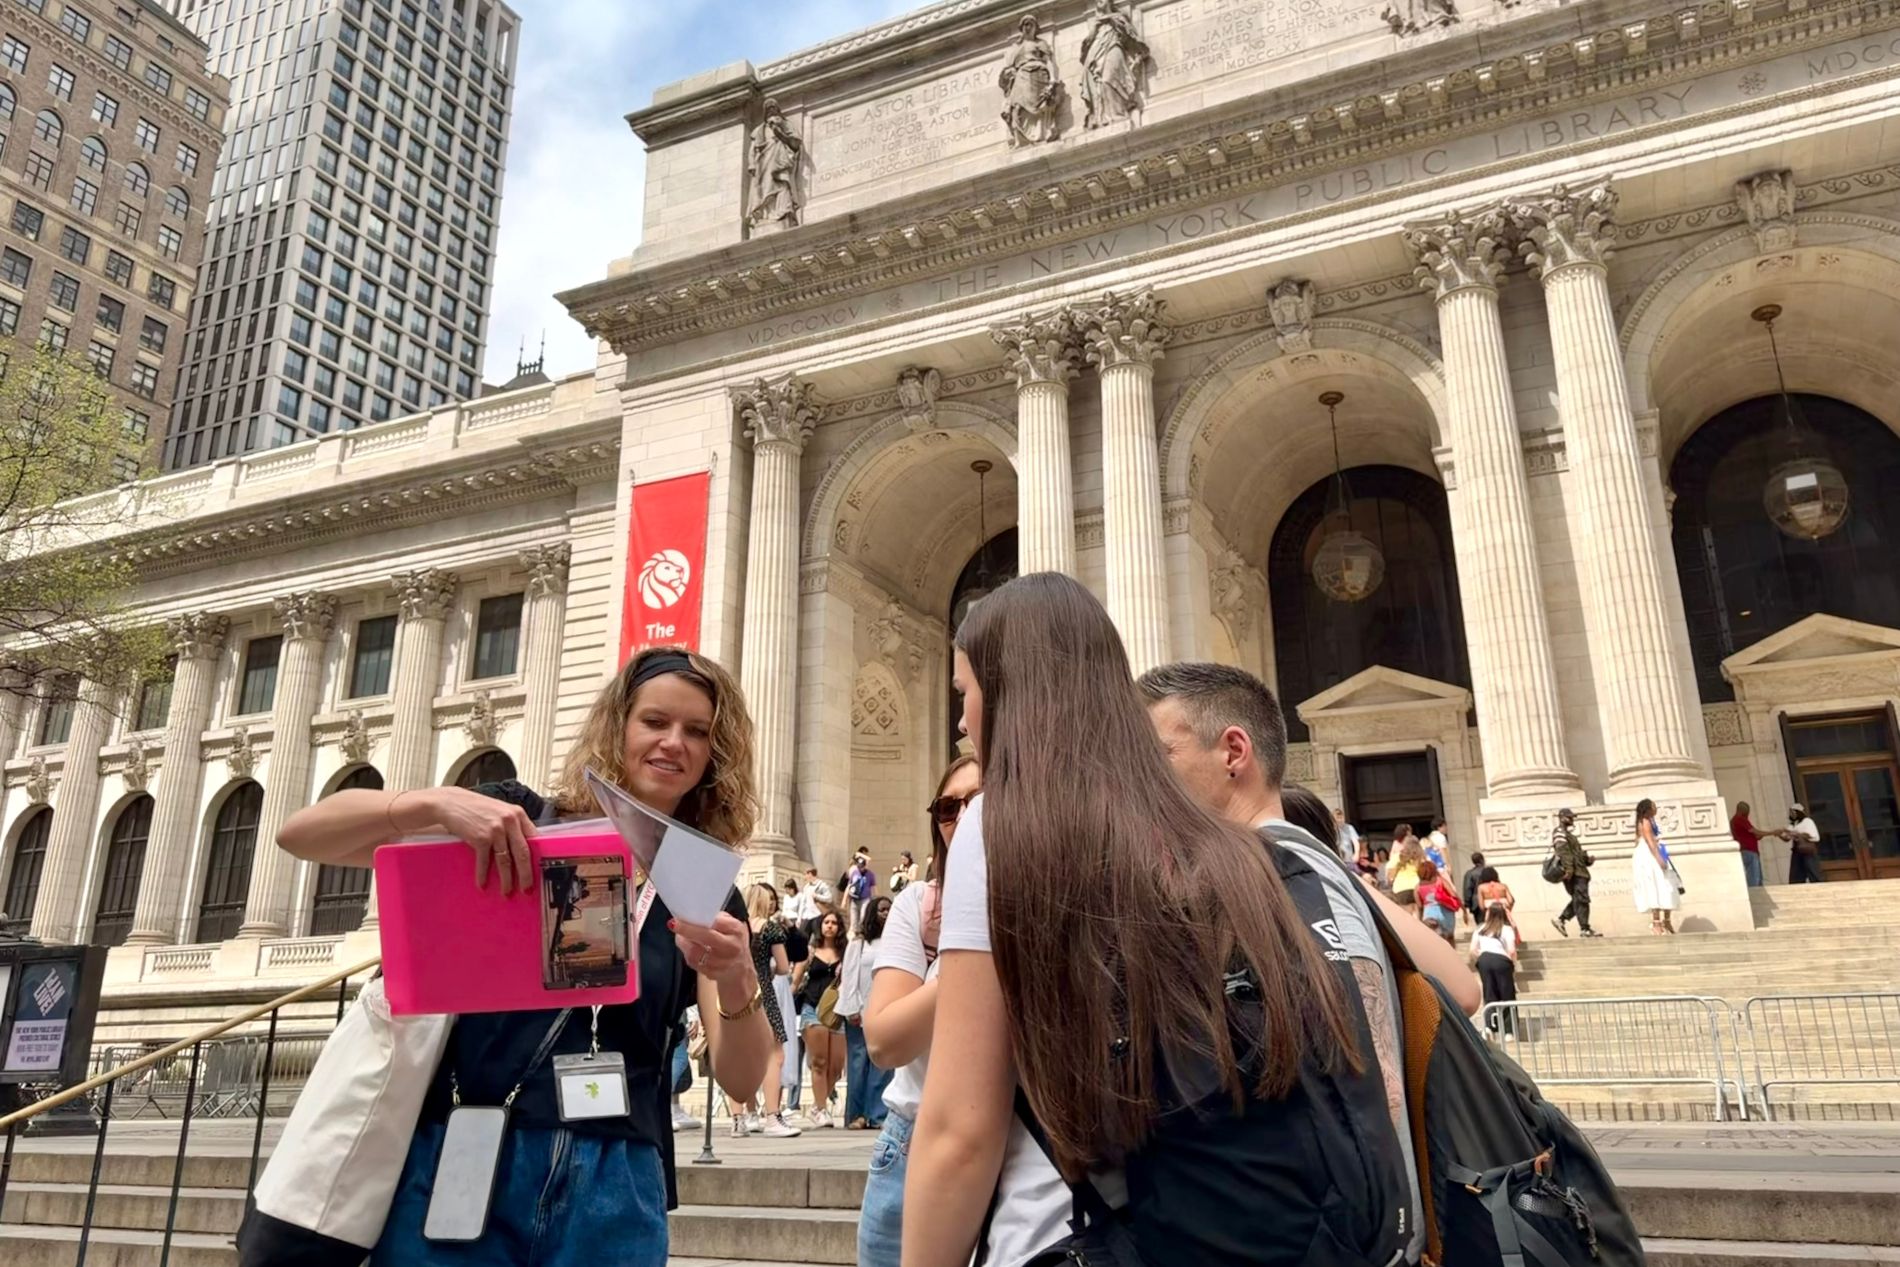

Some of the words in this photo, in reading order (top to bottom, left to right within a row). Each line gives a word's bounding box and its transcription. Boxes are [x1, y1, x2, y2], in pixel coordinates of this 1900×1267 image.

[1155, 5, 1192, 29] THE
[1201, 18, 1254, 43] JAMES
[1156, 52, 1232, 80] LITERATURE
[1242, 39, 1266, 55] AND
[1275, 30, 1299, 43] THE
[1307, 20, 1336, 34] FINE
[1343, 7, 1376, 25] ARTS
[1183, 32, 1250, 60] DEDICATED
[1226, 41, 1302, 71] MDCCCLXX
[824, 113, 853, 134] THE
[863, 94, 914, 122] ASTOR
[924, 67, 994, 102] LIBRARY
[843, 136, 876, 155] JOHN
[882, 122, 924, 143] JACOB
[930, 106, 970, 128] ASTOR
[931, 266, 1001, 301] THE
[1030, 235, 1120, 278] NEW
[1155, 198, 1258, 244] YORK
[1295, 149, 1449, 209] PUBLIC
[1494, 85, 1696, 159] LIBRARY
[645, 622, 676, 639] The
